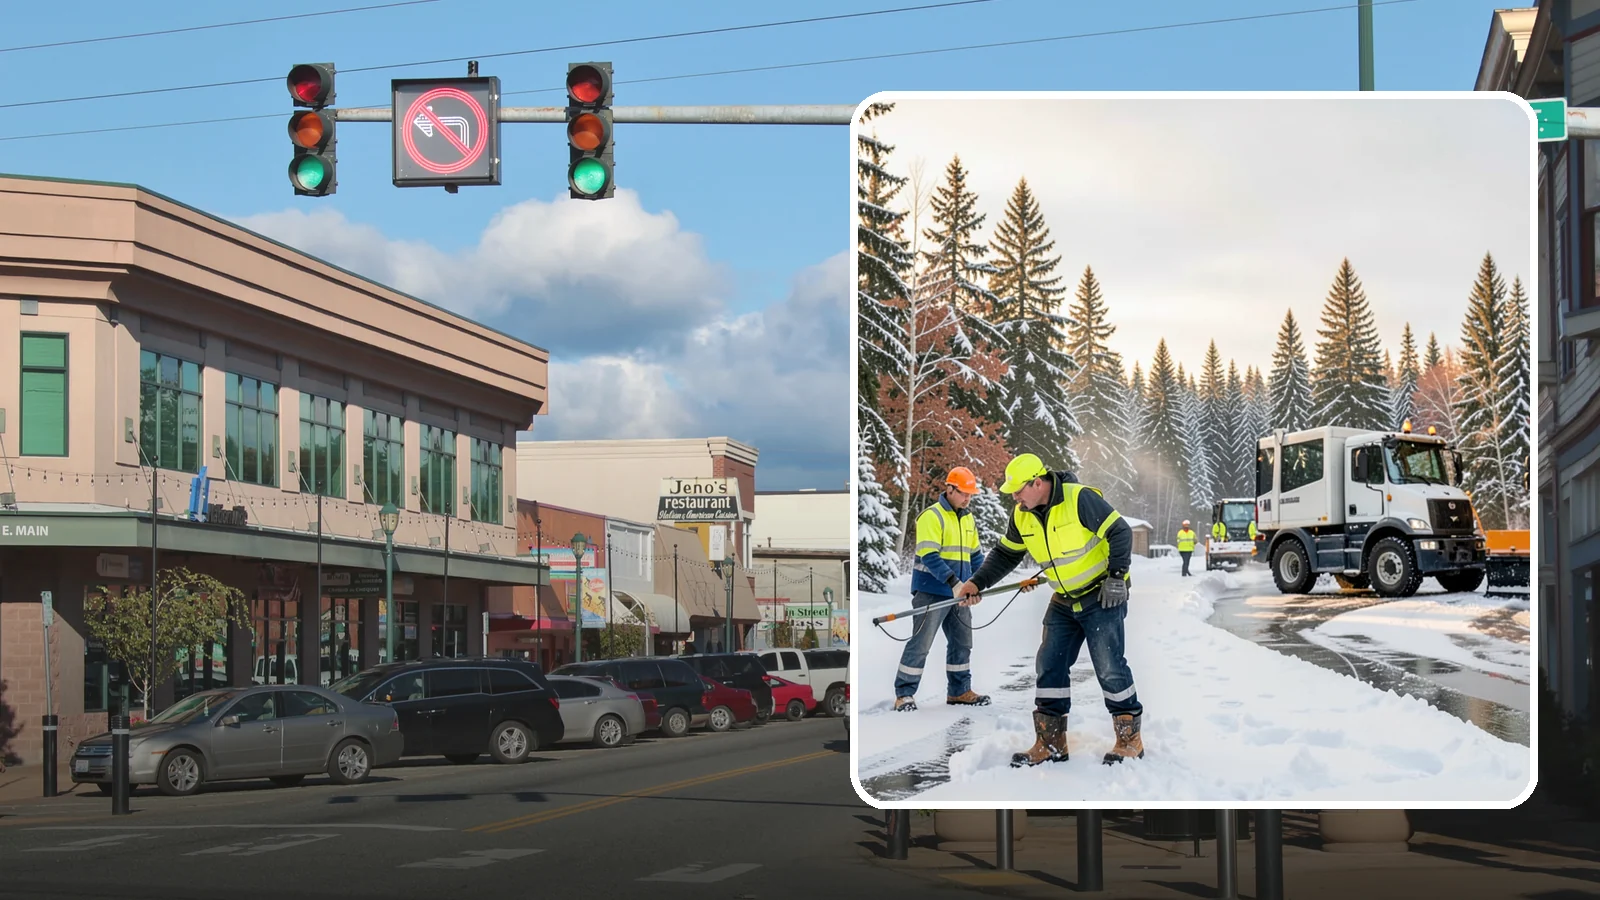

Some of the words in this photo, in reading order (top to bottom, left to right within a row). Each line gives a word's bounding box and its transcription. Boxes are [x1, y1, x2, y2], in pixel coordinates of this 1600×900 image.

[670, 480, 727, 494] Jeno's
[665, 496, 731, 509] restaurant
[686, 510, 714, 519] American
[715, 510, 738, 519] Cuisine
[2, 525, 13, 536] E.
[15, 525, 49, 536] MAIN
[797, 607, 828, 617] Street
